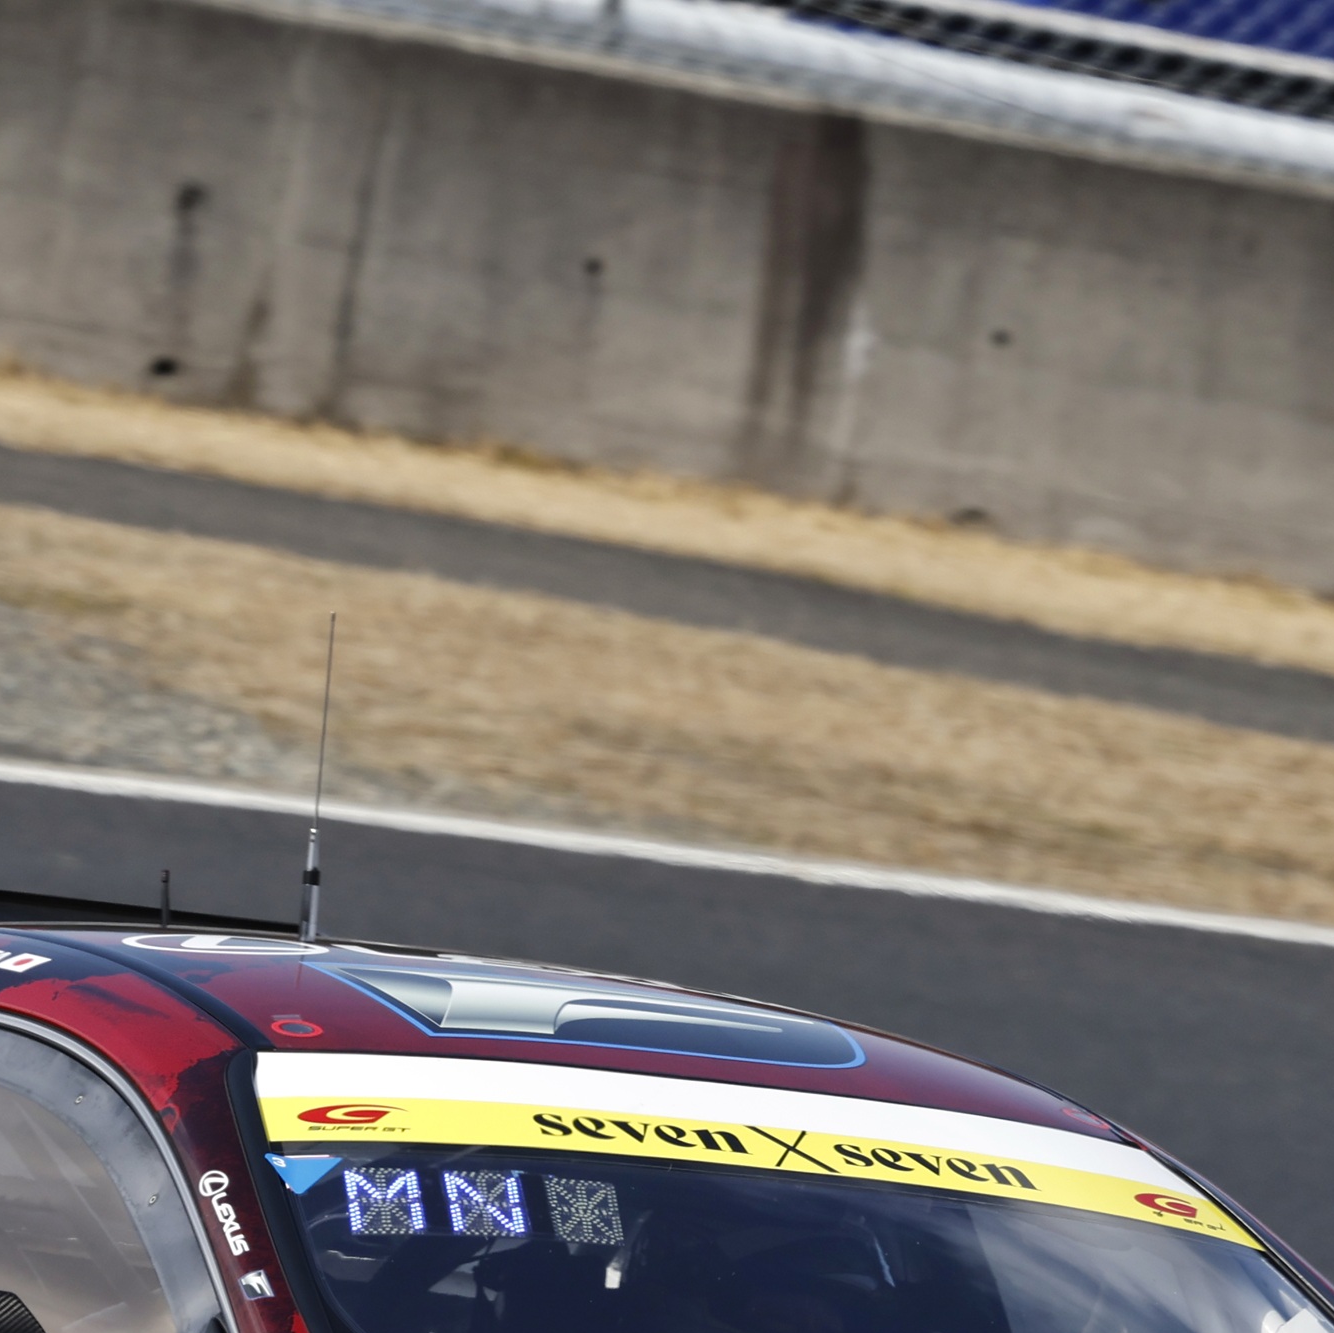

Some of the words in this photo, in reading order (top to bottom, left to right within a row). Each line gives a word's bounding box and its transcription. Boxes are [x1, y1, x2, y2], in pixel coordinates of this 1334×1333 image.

[533, 1113, 754, 1155] seven
[833, 1143, 1042, 1191] seven
[211, 1192, 250, 1256] LEXUS
